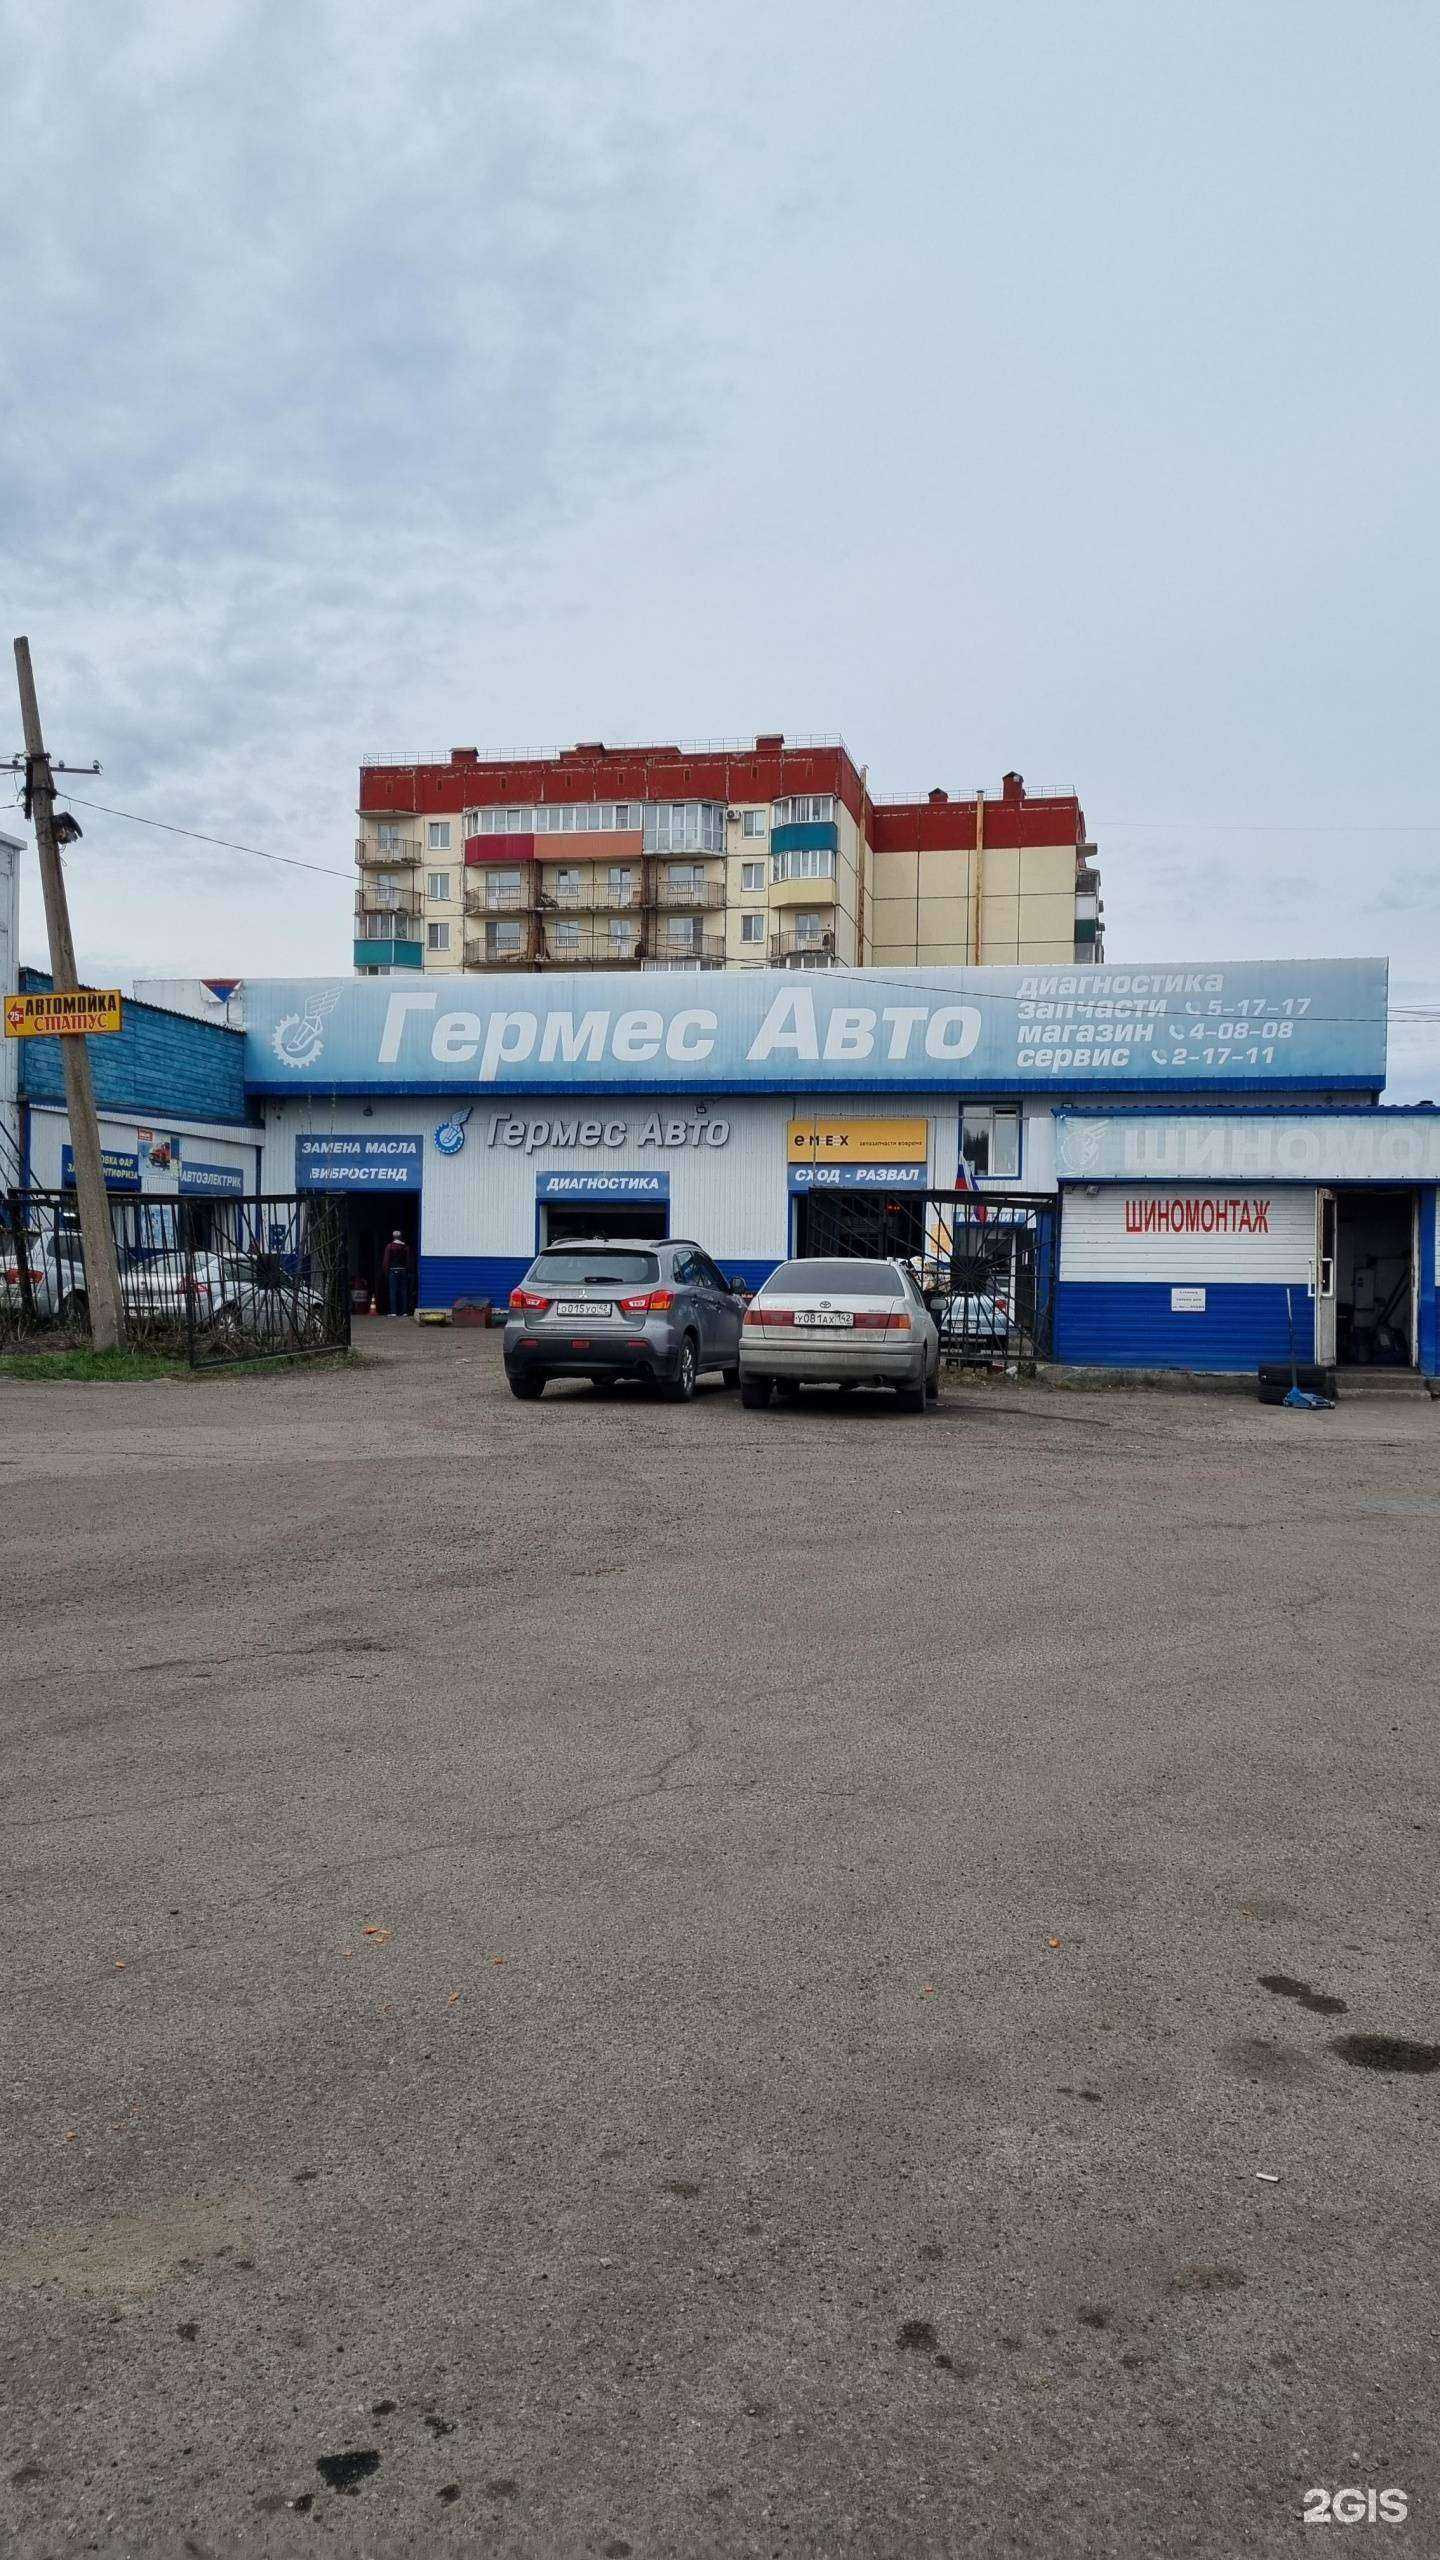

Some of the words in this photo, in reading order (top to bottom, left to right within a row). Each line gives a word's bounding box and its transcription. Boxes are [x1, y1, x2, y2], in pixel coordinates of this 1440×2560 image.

[1016, 974, 1224, 999] диагностика
[25, 995, 117, 1016] АВТОМОЙКА
[1017, 997, 1167, 1019] запчасти
[1207, 998, 1311, 1016] 5-17-17
[377, 992, 718, 1081] Гермес
[746, 986, 982, 1061] Авто
[1016, 1022, 1154, 1043] магазин
[1190, 1022, 1293, 1039] 4-08-08
[1016, 1047, 1130, 1074] сервис
[1172, 1047, 1275, 1065] 2-17-11
[486, 1112, 627, 1155] Гермес
[637, 1112, 730, 1148] Авто
[302, 1142, 360, 1154] ЗАМЕНА
[365, 1142, 416, 1154] МАСЛА
[1125, 1128, 1440, 1170] ШИНОМО
[102, 1168, 138, 1179] НТИФРИЗА
[181, 1170, 242, 1187] АВТОЭЛЕКТРИК
[310, 1167, 407, 1181] ВИБРОСТЕНД
[795, 1169, 841, 1183] СХОД
[855, 1169, 919, 1181] РАЗВАЛ
[547, 1177, 659, 1192] ДИАГНОСТИКА
[1125, 1200, 1271, 1233] ШИНОМОНТАЖ
